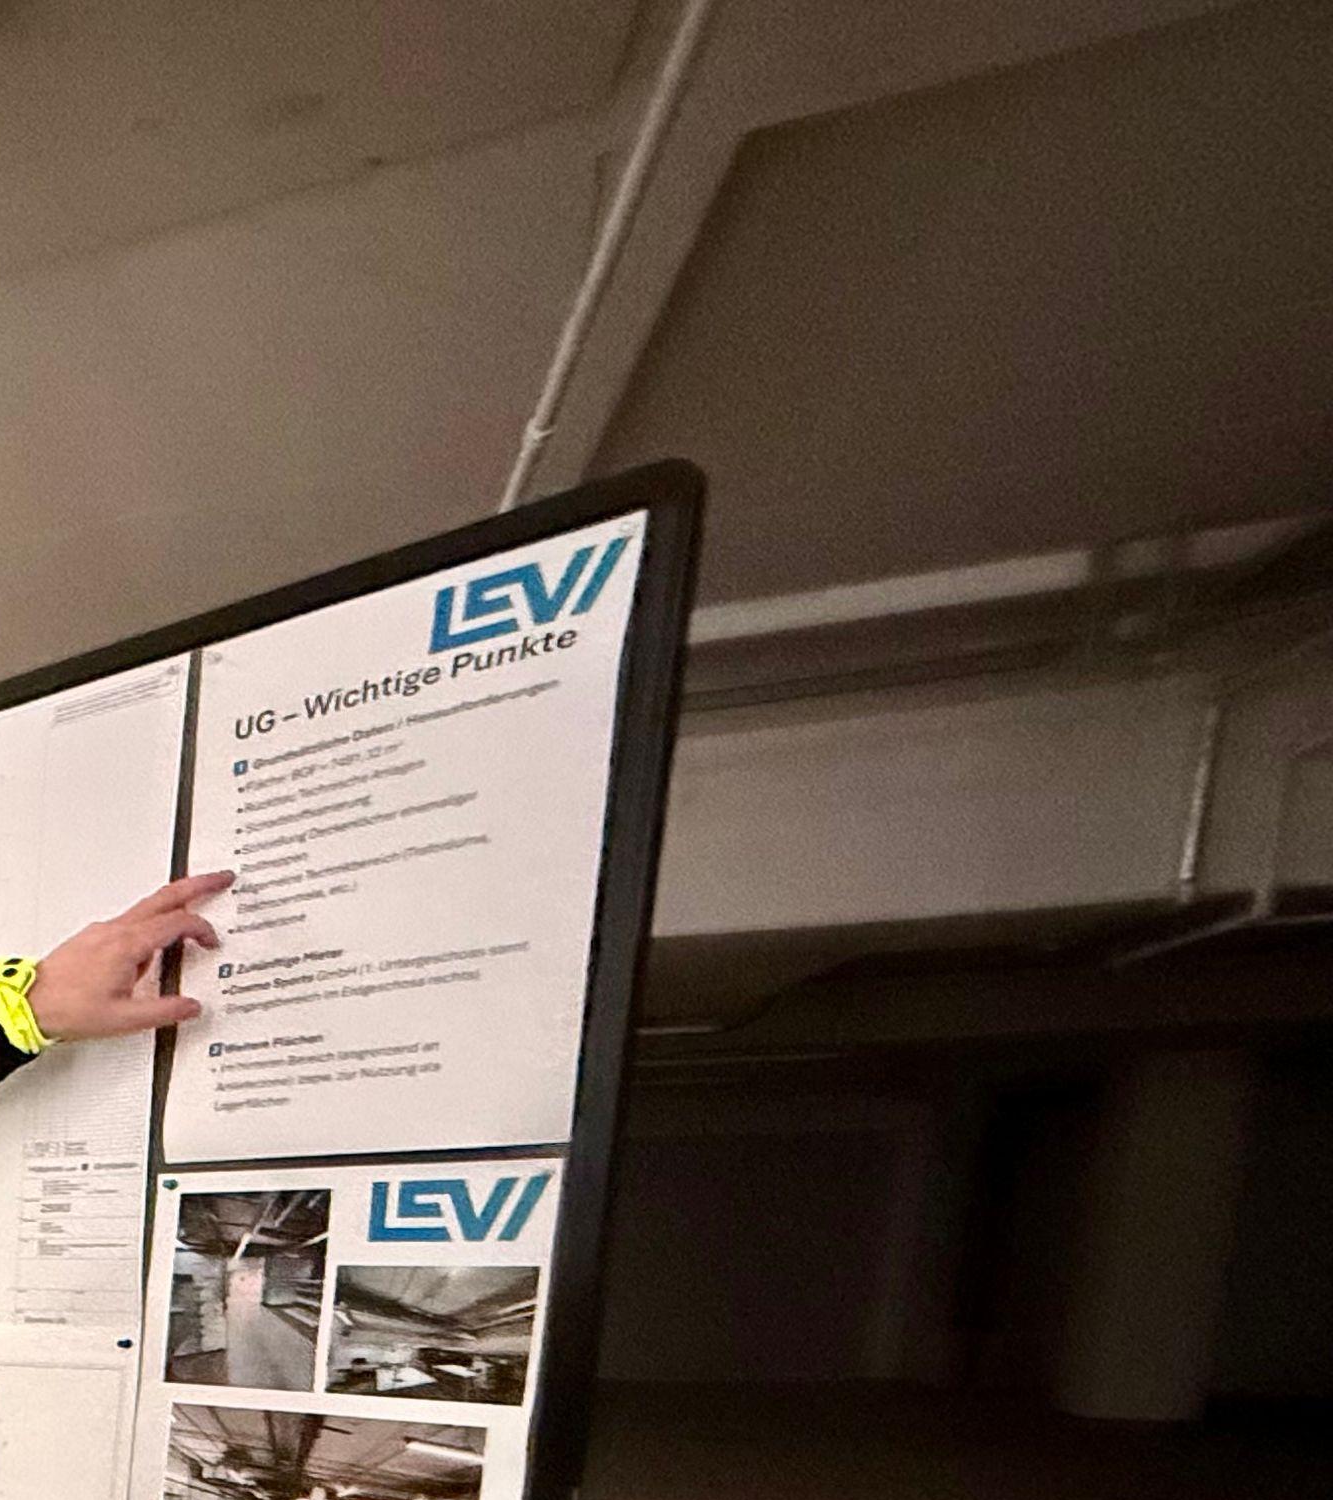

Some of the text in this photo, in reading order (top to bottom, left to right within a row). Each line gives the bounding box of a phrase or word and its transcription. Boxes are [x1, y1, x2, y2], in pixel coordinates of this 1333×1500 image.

[428, 536, 633, 654] LEVI
[235, 710, 277, 740] UG
[304, 666, 441, 721] Wichtige
[451, 627, 579, 679] Punkte
[368, 1169, 551, 1242] LEVI
